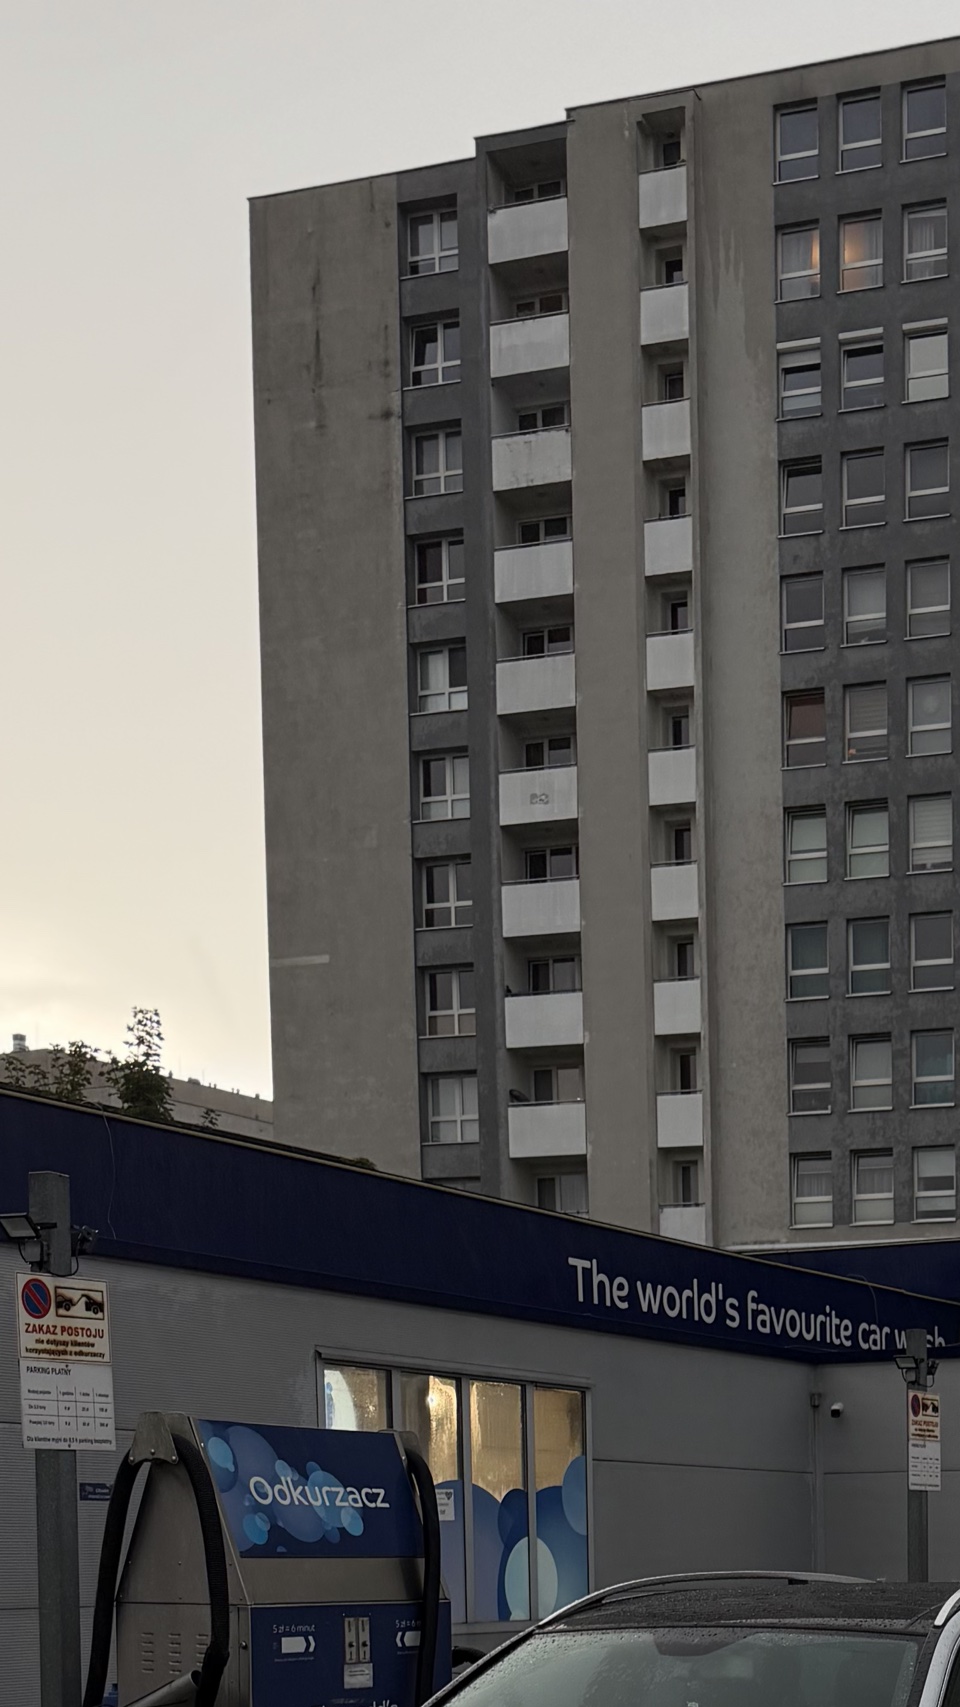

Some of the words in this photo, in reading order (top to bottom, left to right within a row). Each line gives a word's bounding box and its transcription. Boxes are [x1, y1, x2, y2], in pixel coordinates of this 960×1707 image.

[567, 1256, 629, 1310] The
[636, 1277, 741, 1329] world's
[747, 1289, 853, 1348] favourite
[857, 1321, 891, 1350] car
[894, 1324, 946, 1350] wsh
[25, 1323, 57, 1335] ZAKAZ
[60, 1325, 104, 1339] POSTOJU
[35, 1337, 44, 1345] nie
[26, 1366, 50, 1375] PARKING
[249, 1476, 390, 1508] Odkurzacz
[395, 1619, 400, 1628] 5
[272, 1624, 278, 1633] 5
[290, 1624, 296, 1632] 6
[296, 1624, 316, 1632] minut
